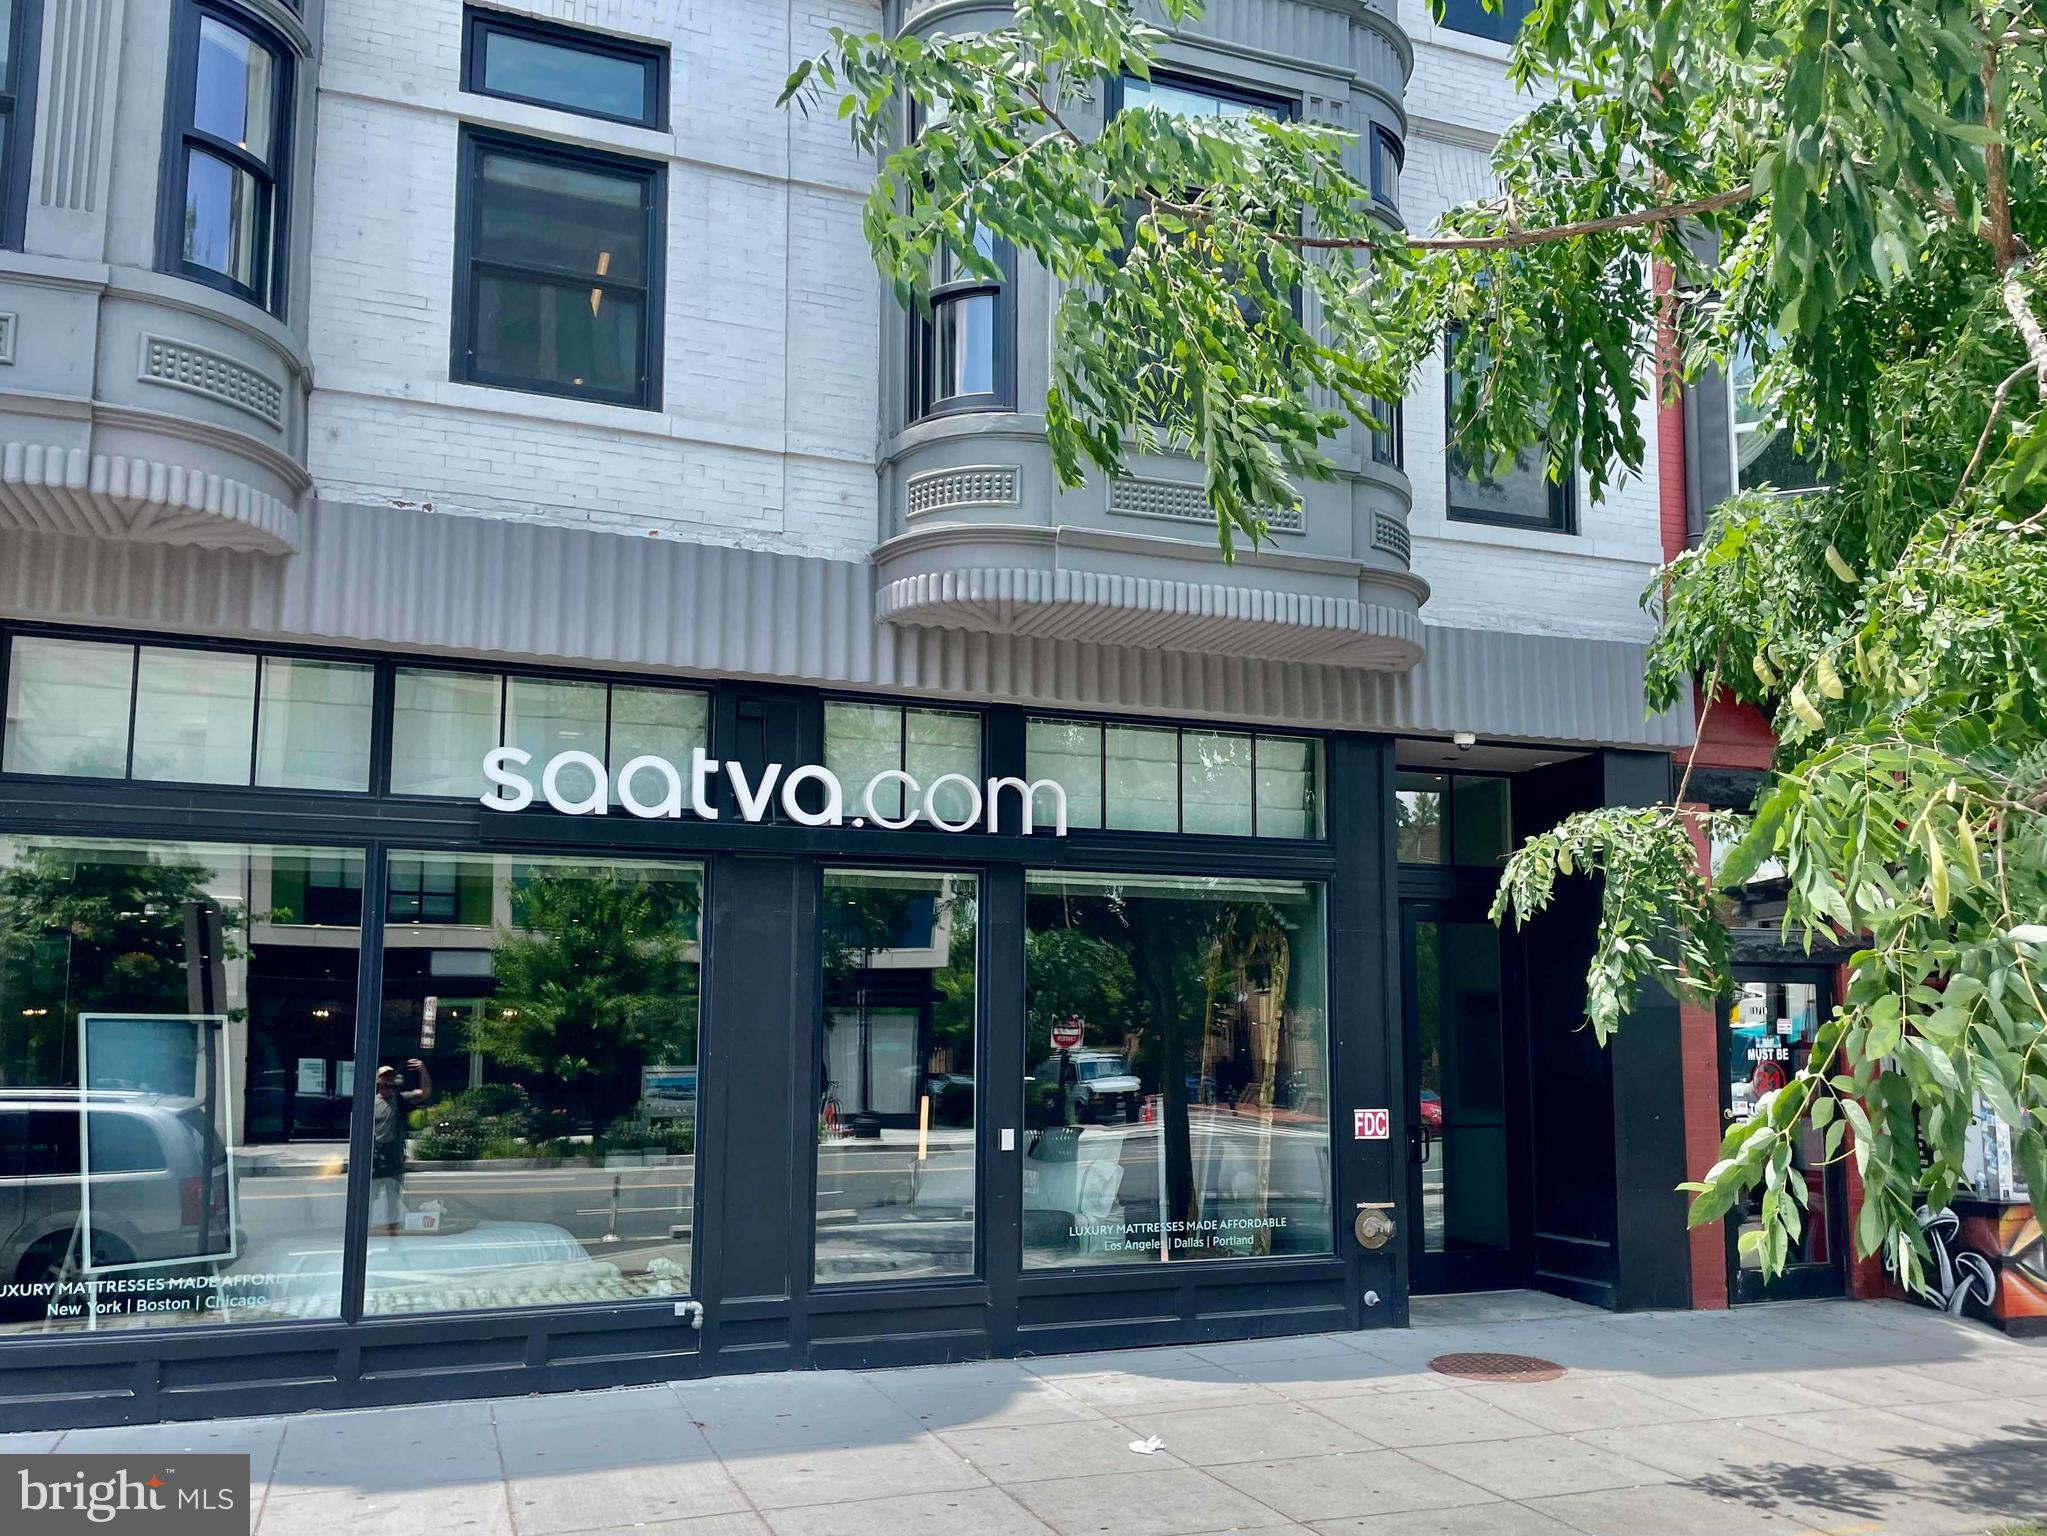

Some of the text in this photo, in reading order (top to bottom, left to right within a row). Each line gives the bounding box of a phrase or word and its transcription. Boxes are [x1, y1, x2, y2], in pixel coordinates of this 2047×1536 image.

[480, 747, 1067, 837] saatva.com
[1747, 1048, 1789, 1060] MUST BE
[1355, 1112, 1386, 1136] FDC
[1069, 1217, 1287, 1237] LUXURY MATTRESSES MADE AFFORDABLE
[1104, 1240, 1122, 1251] Los
[1174, 1236, 1204, 1249] Dallas
[1213, 1234, 1254, 1247] Portland
[58, 1278, 165, 1296] MATTRESSES
[169, 1275, 217, 1290] MADE
[47, 1302, 82, 1317] New
[87, 1299, 122, 1315] York
[136, 1298, 190, 1312] Boston
[205, 1293, 266, 1310] Chicago
